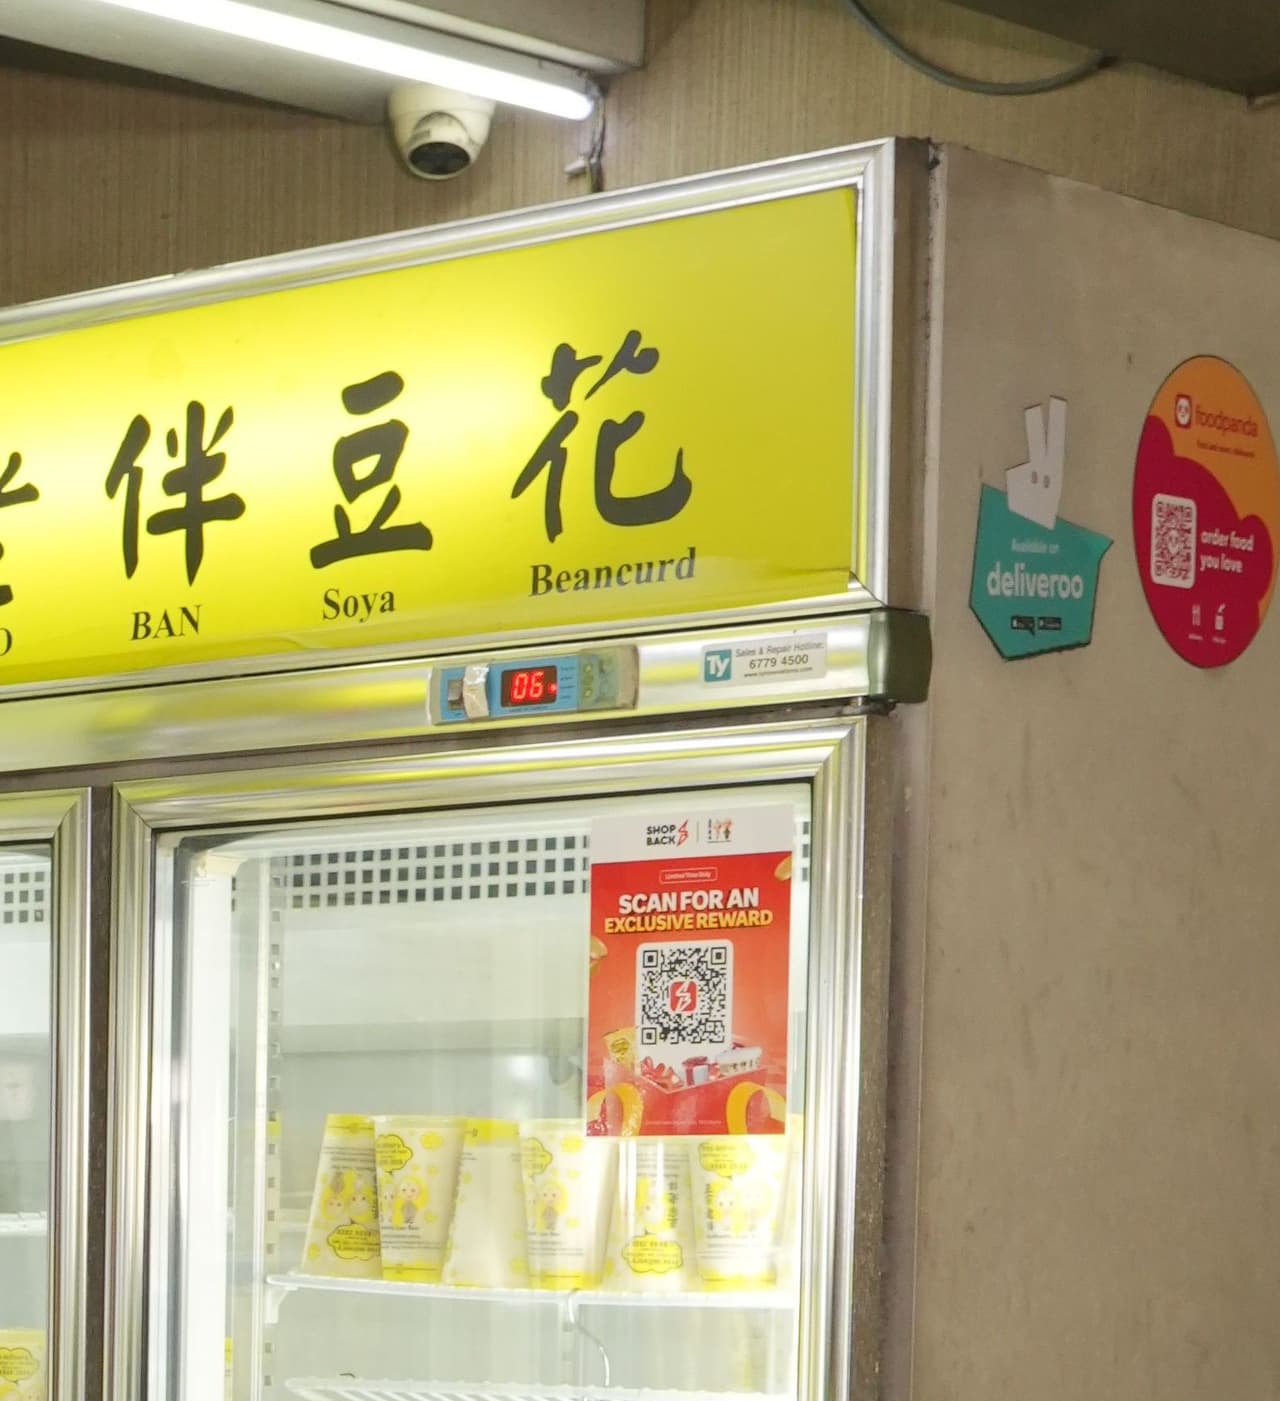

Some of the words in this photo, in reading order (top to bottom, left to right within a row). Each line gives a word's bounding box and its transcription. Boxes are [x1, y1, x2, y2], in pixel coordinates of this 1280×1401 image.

[987, 561, 1083, 599] deliveroo
[131, 604, 201, 643] BAN
[321, 588, 396, 627] Soya
[528, 547, 698, 598] Beancurd
[749, 657, 777, 670] 6779
[780, 654, 808, 667] 4500
[646, 825, 676, 835] SHOP
[646, 836, 676, 846] BACK
[619, 892, 677, 914] SCAN
[680, 889, 724, 911] FOR
[727, 887, 759, 909] AN
[604, 913, 694, 933] EXCLUSIVE
[696, 909, 773, 929] REWARD
